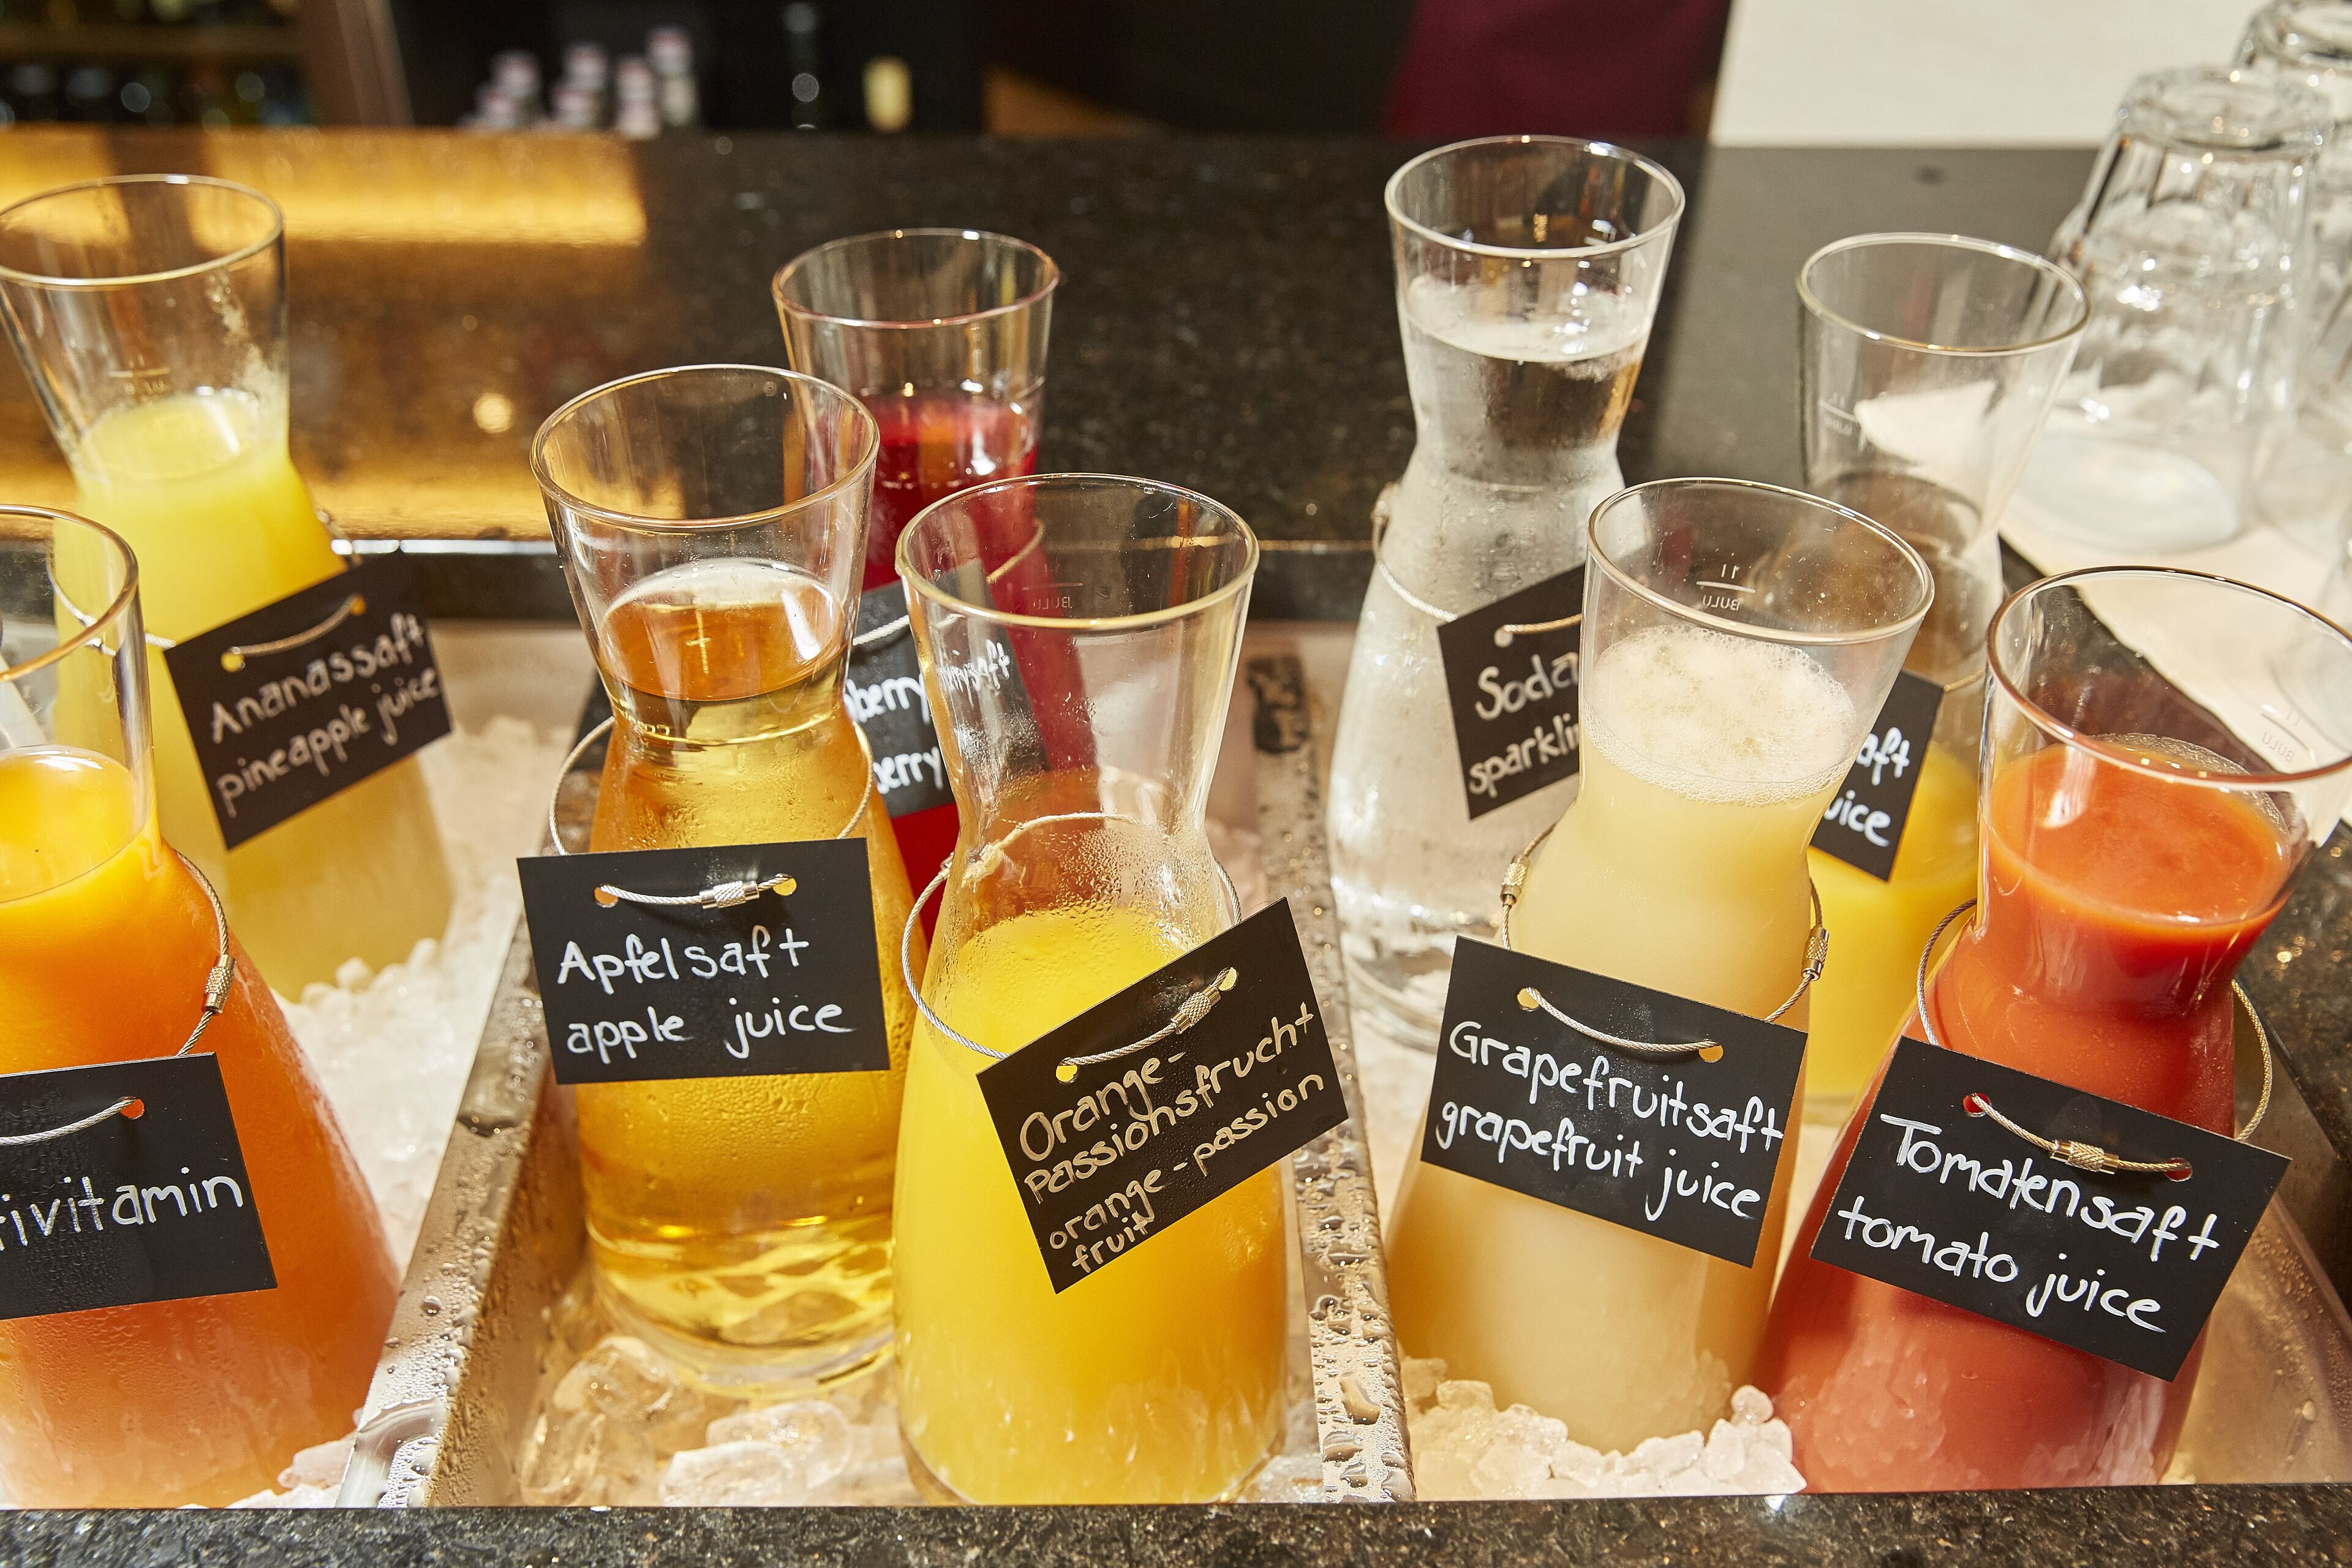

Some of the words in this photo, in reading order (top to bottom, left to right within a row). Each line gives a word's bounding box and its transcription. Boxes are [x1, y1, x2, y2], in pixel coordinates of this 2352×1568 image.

[212, 612, 425, 745] Ananassaft
[1474, 652, 1579, 721] Soda
[216, 704, 371, 818] pineapple
[371, 667, 440, 747] juice
[557, 924, 810, 995] Apfelsaft
[567, 1006, 695, 1065] apple
[723, 997, 857, 1060] juice
[1449, 1020, 1785, 1154] Grapefruitsaft
[1019, 1051, 1187, 1162] Orange-
[1435, 1101, 1644, 1178] grapefruit
[1645, 1148, 1761, 1222] juice
[1072, 1210, 1149, 1273] fruit
[1880, 1113, 2220, 1262] Tomatensaft
[1837, 1195, 2019, 1283] tomato
[2025, 1252, 2166, 1333] juice
